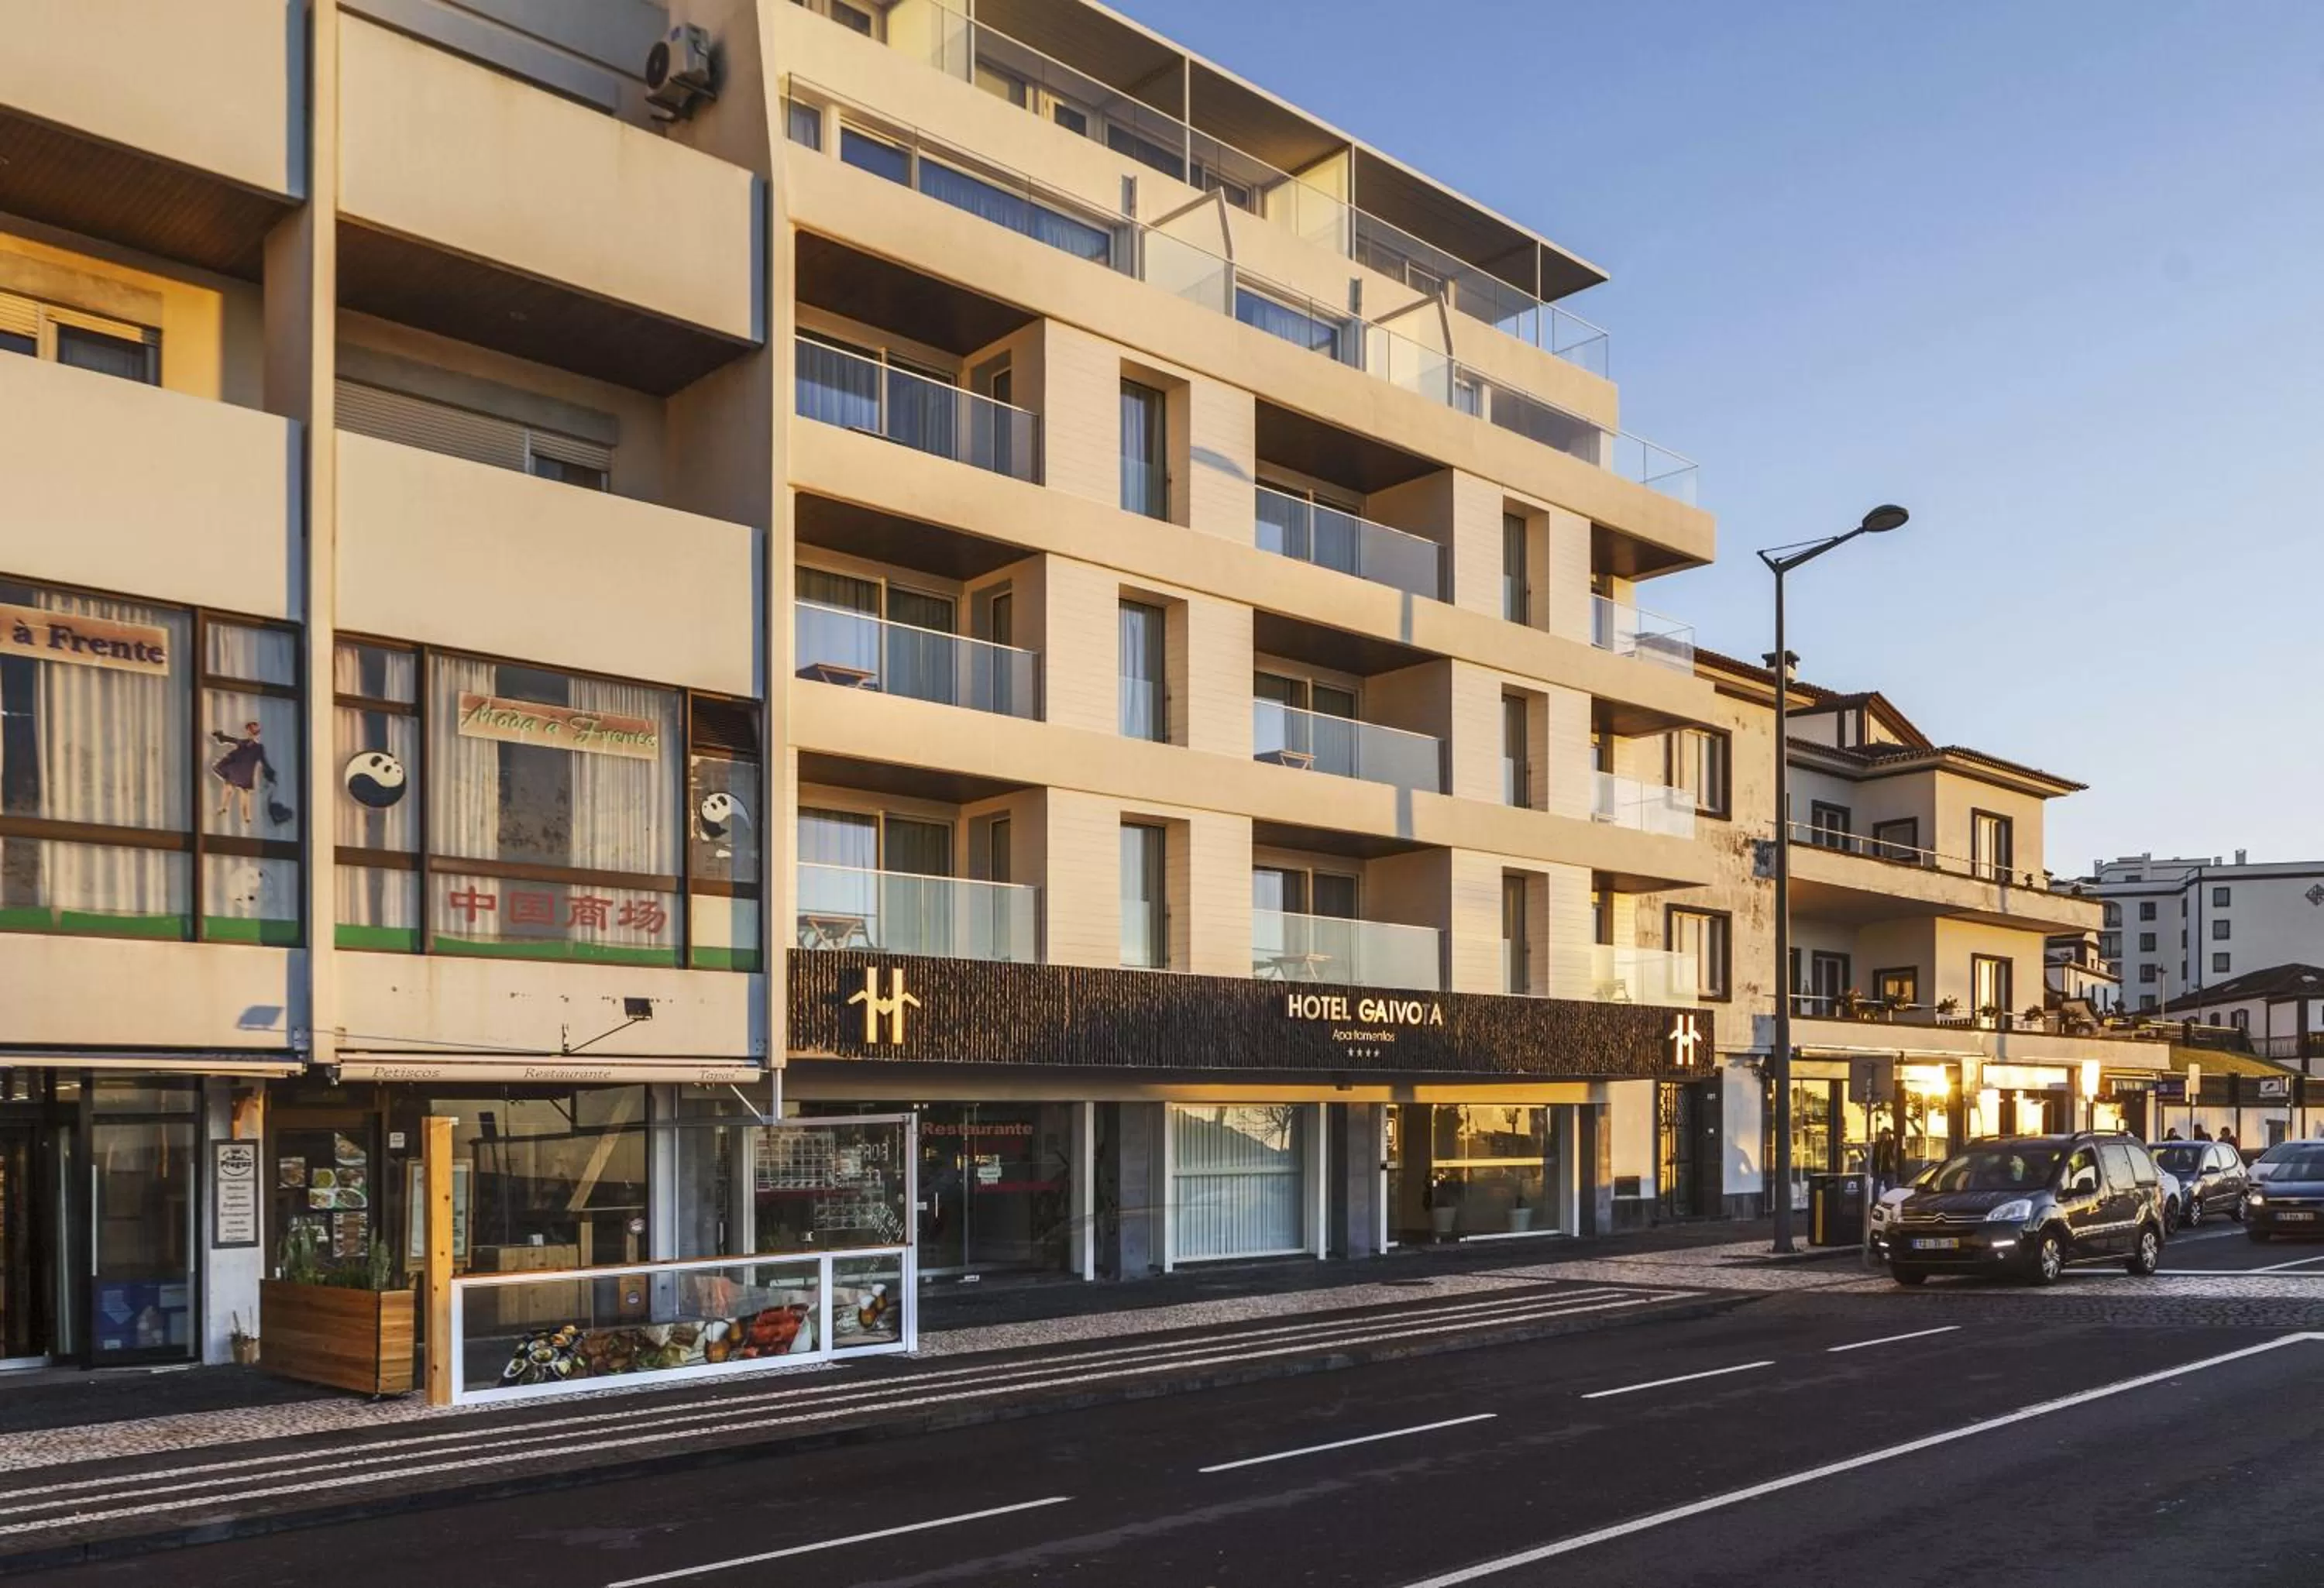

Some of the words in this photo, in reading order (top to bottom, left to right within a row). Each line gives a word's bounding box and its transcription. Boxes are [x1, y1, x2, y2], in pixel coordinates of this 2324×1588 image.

[12, 618, 35, 645] à
[47, 623, 163, 664] Frente
[461, 700, 535, 731] Moda
[449, 885, 666, 933] 中国商场
[1288, 994, 1351, 1021] HOTEL
[1359, 999, 1443, 1026] GAIVOTA
[1332, 1029, 1395, 1042] Apatamentos
[372, 1066, 441, 1078] Petiscos
[524, 1067, 611, 1079] Restaurante
[700, 1070, 735, 1080] Tapas
[921, 1121, 1033, 1136] Restaurante
